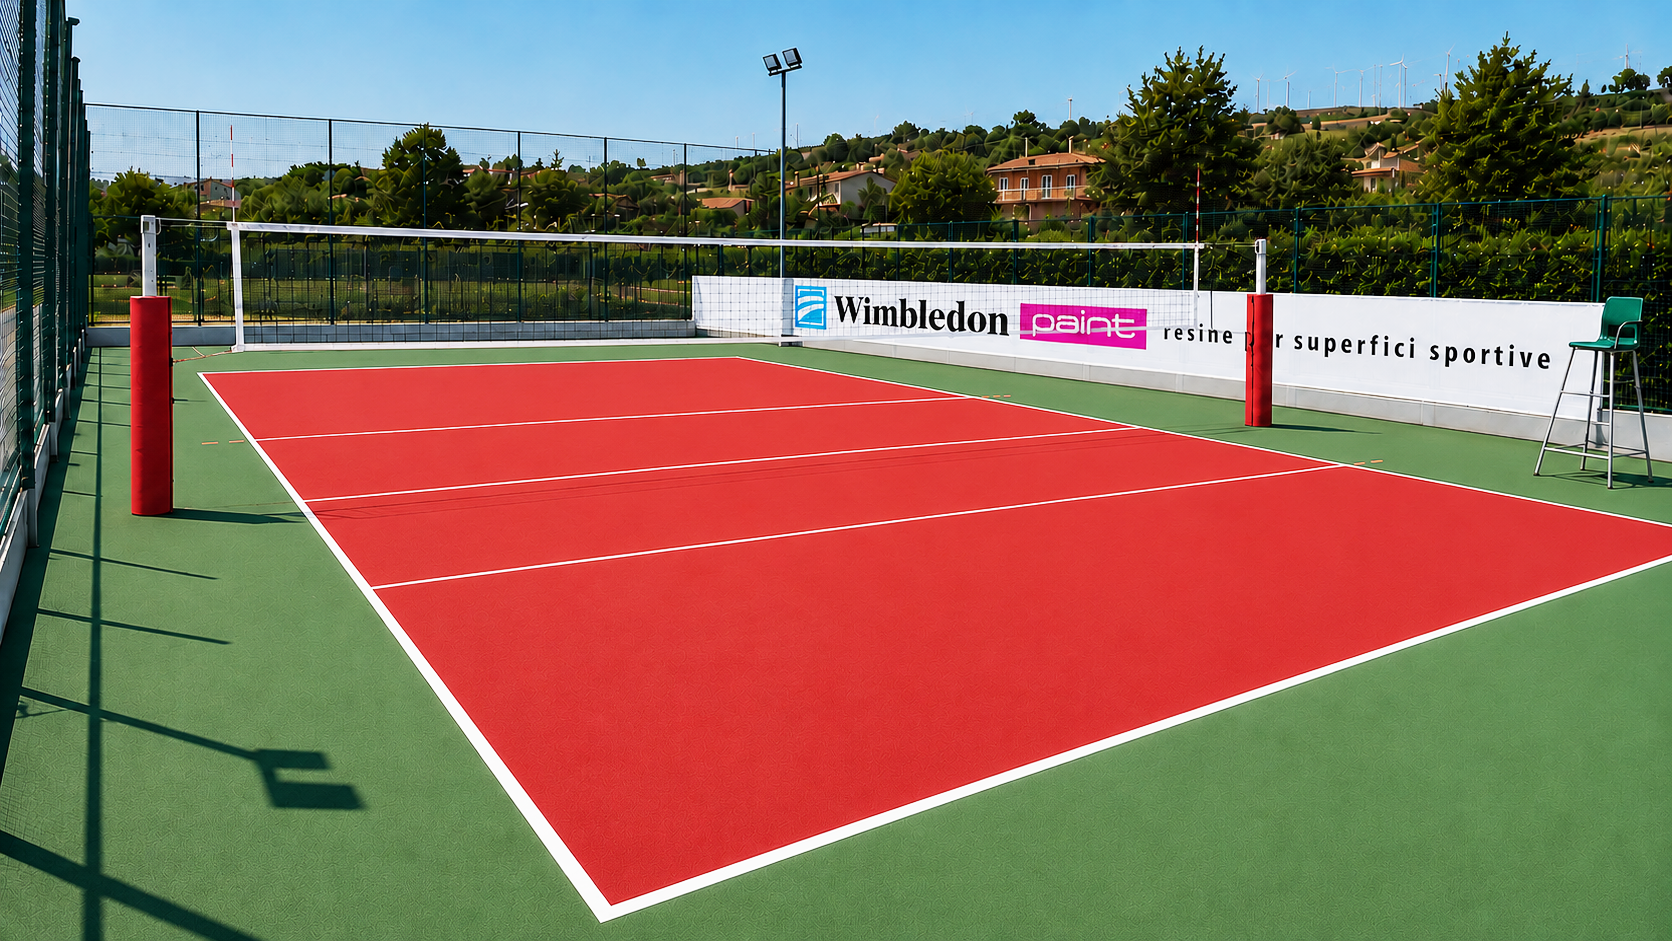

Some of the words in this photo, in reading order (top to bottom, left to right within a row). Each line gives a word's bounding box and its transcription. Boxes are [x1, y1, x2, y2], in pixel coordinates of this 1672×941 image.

[834, 295, 1010, 337] Wimbledon
[1032, 309, 1136, 339] paint
[1164, 323, 1233, 344] resine
[1294, 334, 1416, 359] superfici
[1429, 344, 1552, 370] sportive
